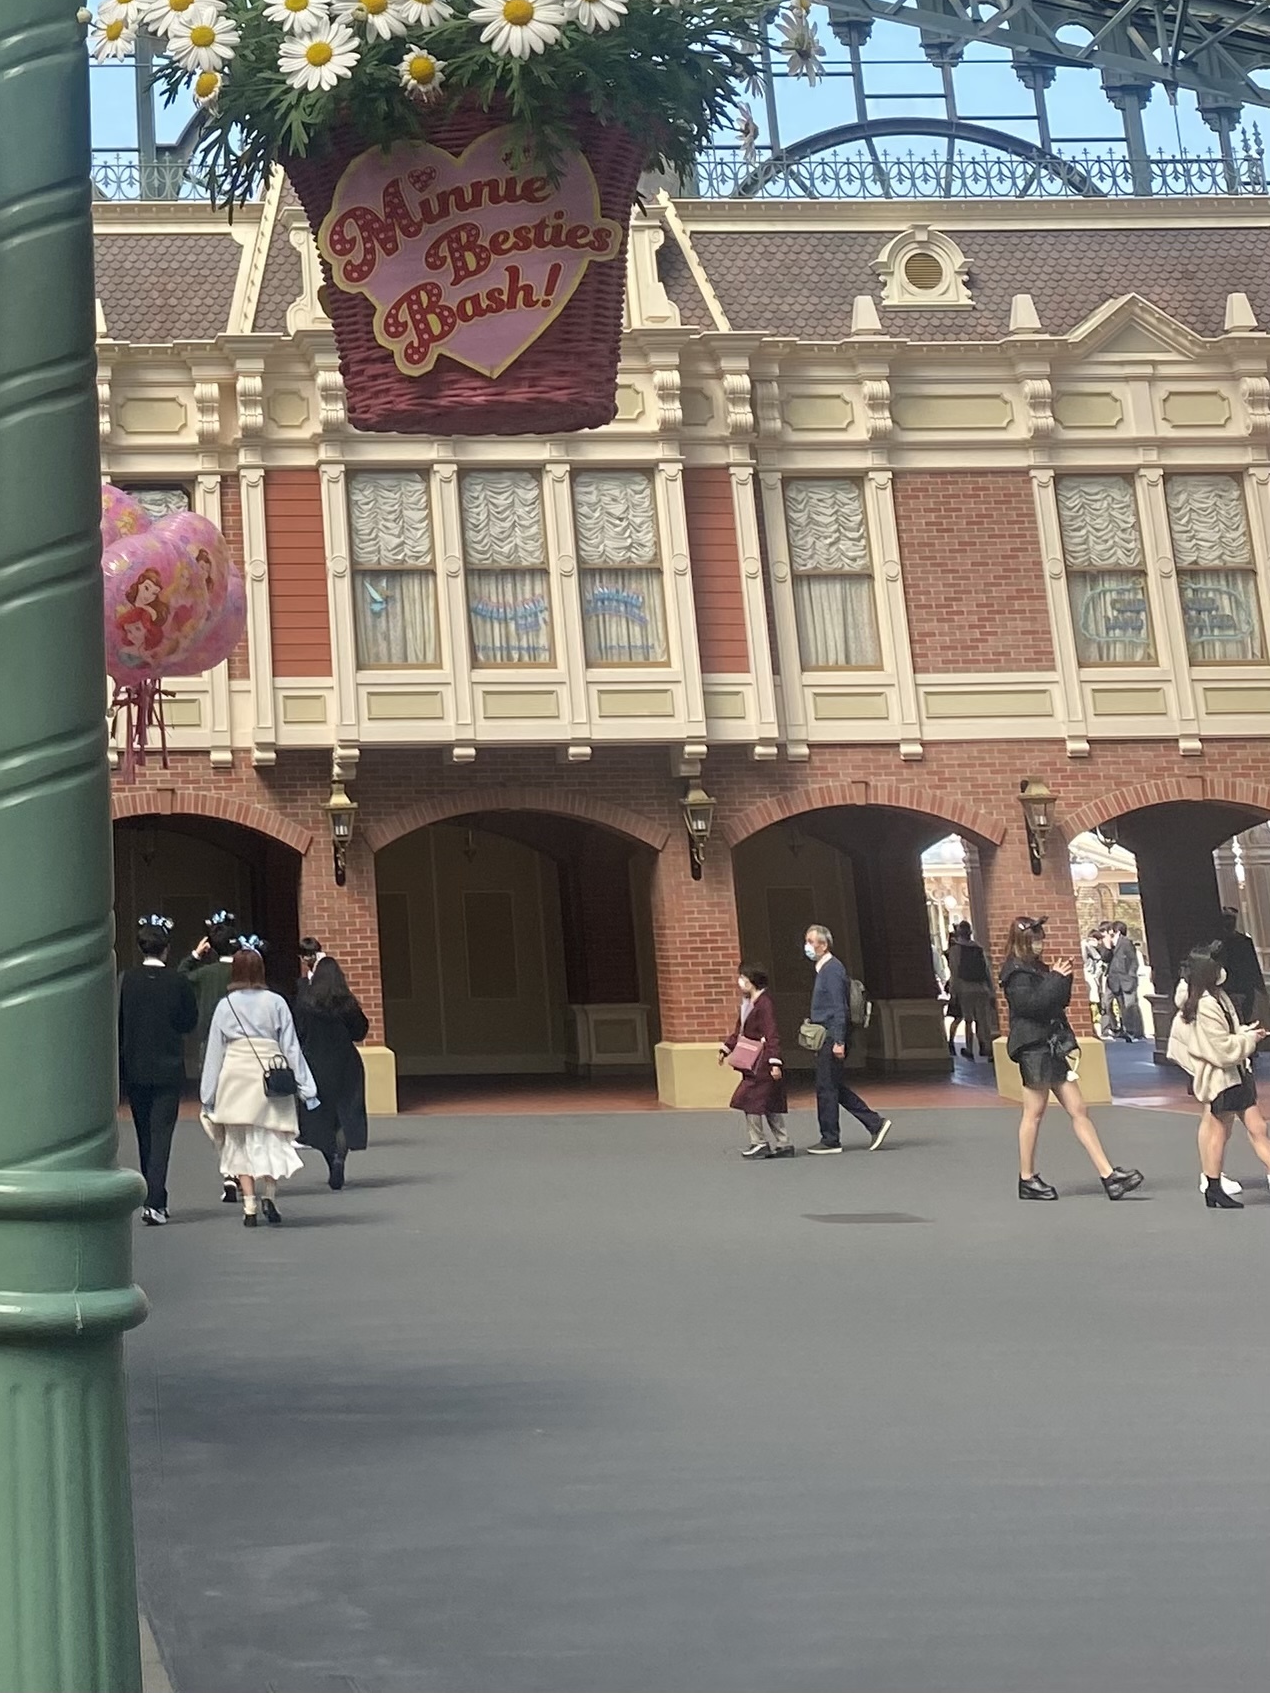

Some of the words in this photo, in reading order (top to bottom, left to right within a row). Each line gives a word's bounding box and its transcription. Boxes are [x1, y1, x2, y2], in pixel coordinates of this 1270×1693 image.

[330, 148, 553, 284] Minnie
[425, 211, 613, 287] Besties
[383, 263, 563, 366] Bash!
